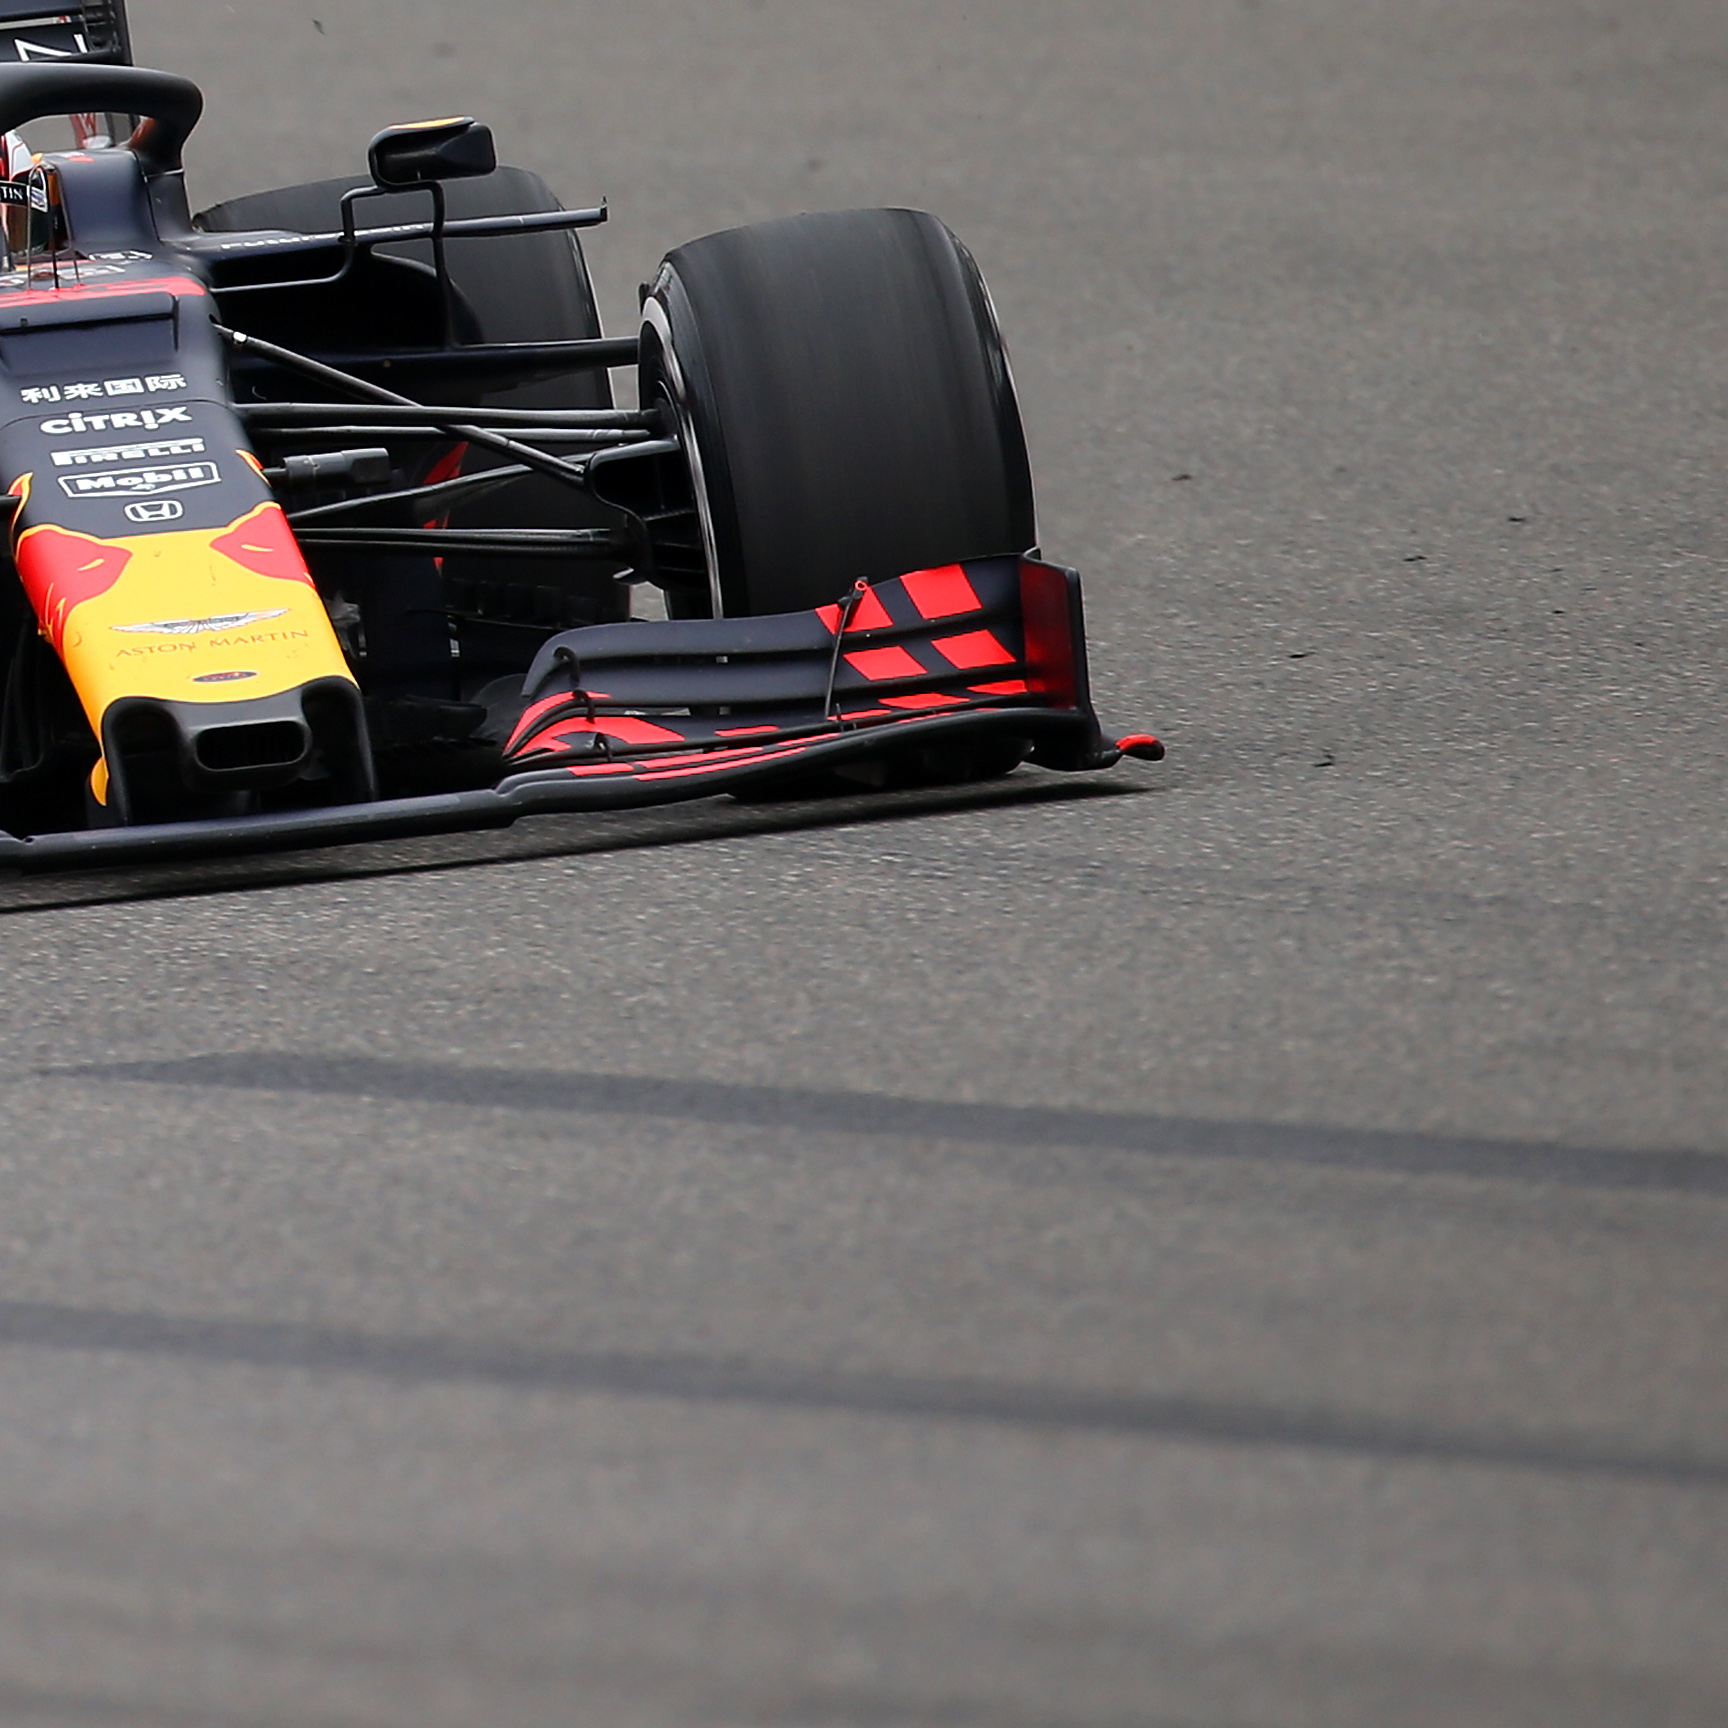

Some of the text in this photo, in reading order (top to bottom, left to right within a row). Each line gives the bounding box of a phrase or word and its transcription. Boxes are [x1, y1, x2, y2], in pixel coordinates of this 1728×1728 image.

[20, 374, 187, 403] 利来国际
[50, 438, 205, 466] PIRELLI
[76, 467, 205, 491] Mobil
[116, 630, 309, 658] ASTON MARTIN
